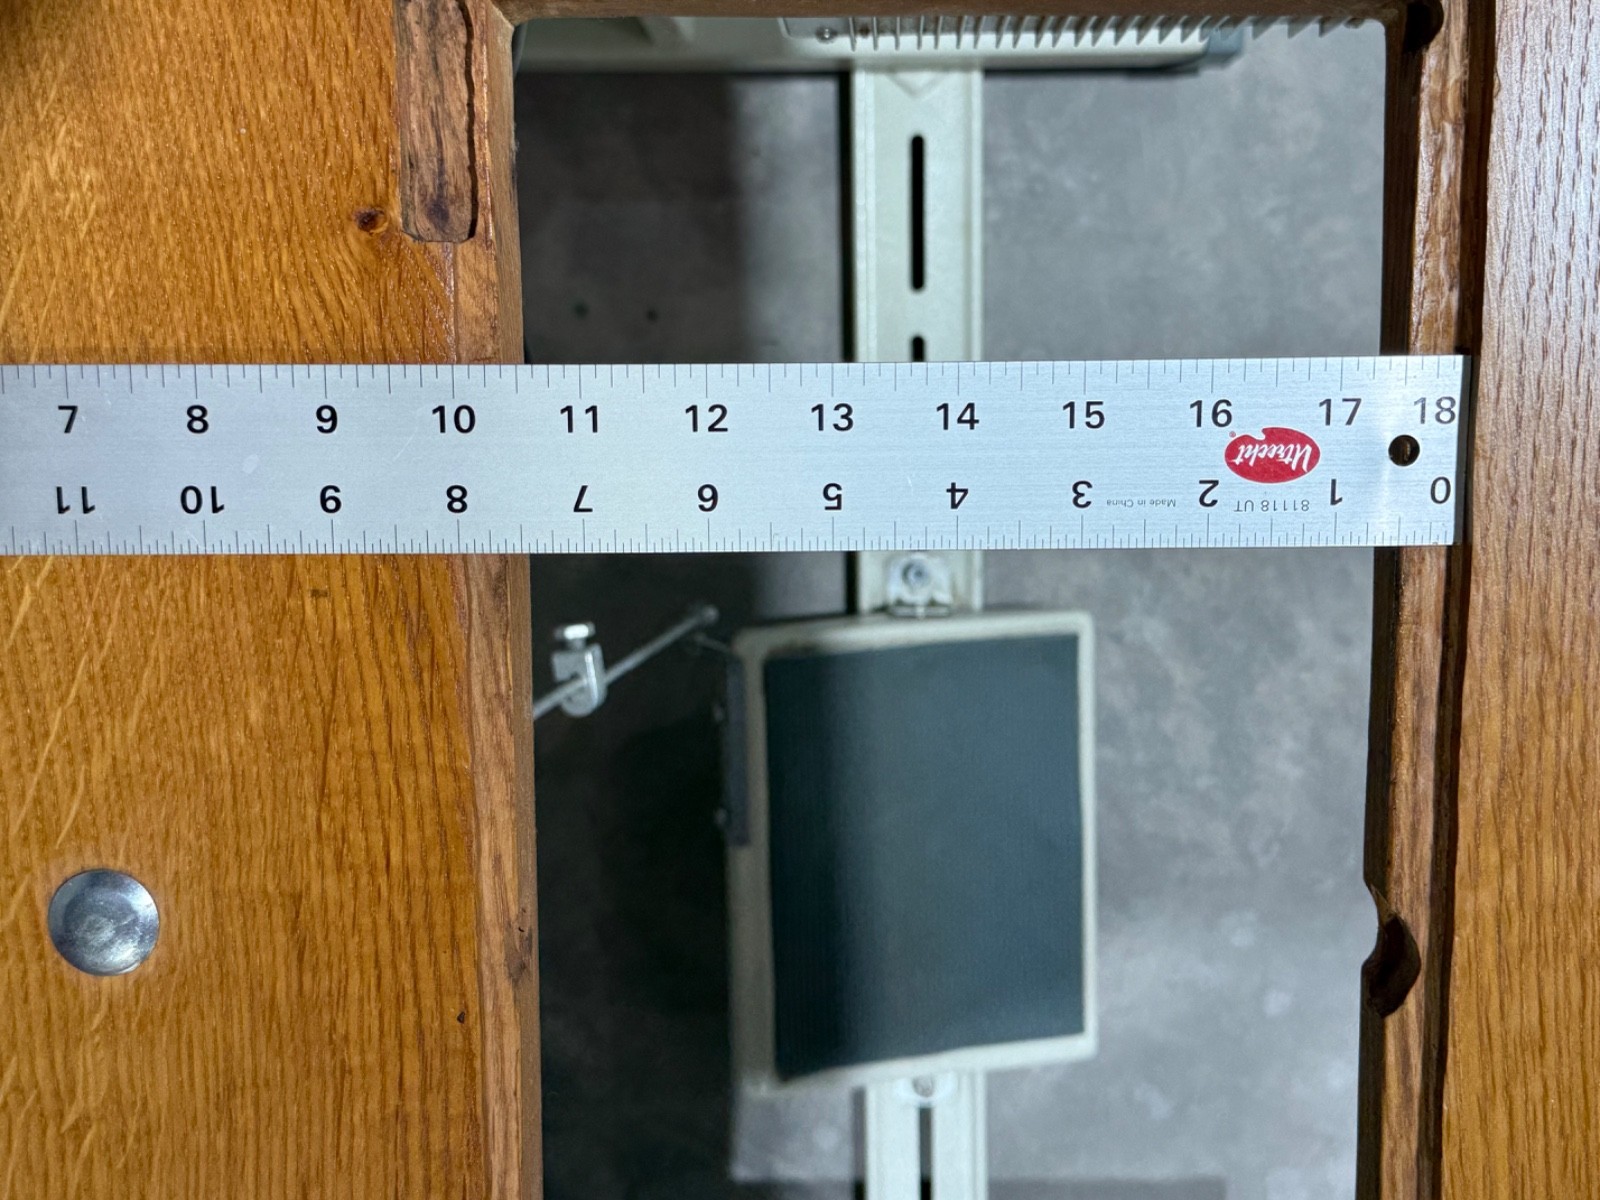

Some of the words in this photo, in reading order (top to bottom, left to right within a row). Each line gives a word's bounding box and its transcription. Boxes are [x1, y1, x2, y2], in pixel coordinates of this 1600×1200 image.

[58, 405, 78, 433] 7
[187, 405, 209, 434] 8
[316, 405, 338, 434] 9
[432, 405, 476, 434] 10
[560, 405, 598, 433] 11
[686, 404, 729, 433] 12
[811, 403, 854, 432] 13
[937, 402, 980, 431] 14
[1063, 401, 1105, 429] 15
[1190, 399, 1232, 427] 16
[1319, 398, 1362, 425] 17
[1414, 397, 1456, 425] 18
[1229, 443, 1313, 473] Utrecht
[56, 486, 95, 515] 11
[180, 486, 225, 515] 10
[320, 485, 342, 514] 9
[446, 485, 468, 514] 8
[573, 485, 594, 513] 7
[698, 484, 719, 513] 6
[823, 483, 843, 511] 5
[946, 482, 969, 510] 4
[1072, 481, 1093, 509] 3
[1106, 498, 1135, 508] China
[1137, 498, 1146, 507] in
[1149, 498, 1177, 508] Made
[1199, 480, 1220, 508] 2
[1330, 479, 1343, 505] 1
[1430, 476, 1451, 505] 0
[1233, 499, 1255, 513] UT
[1261, 499, 1310, 513] 81118
